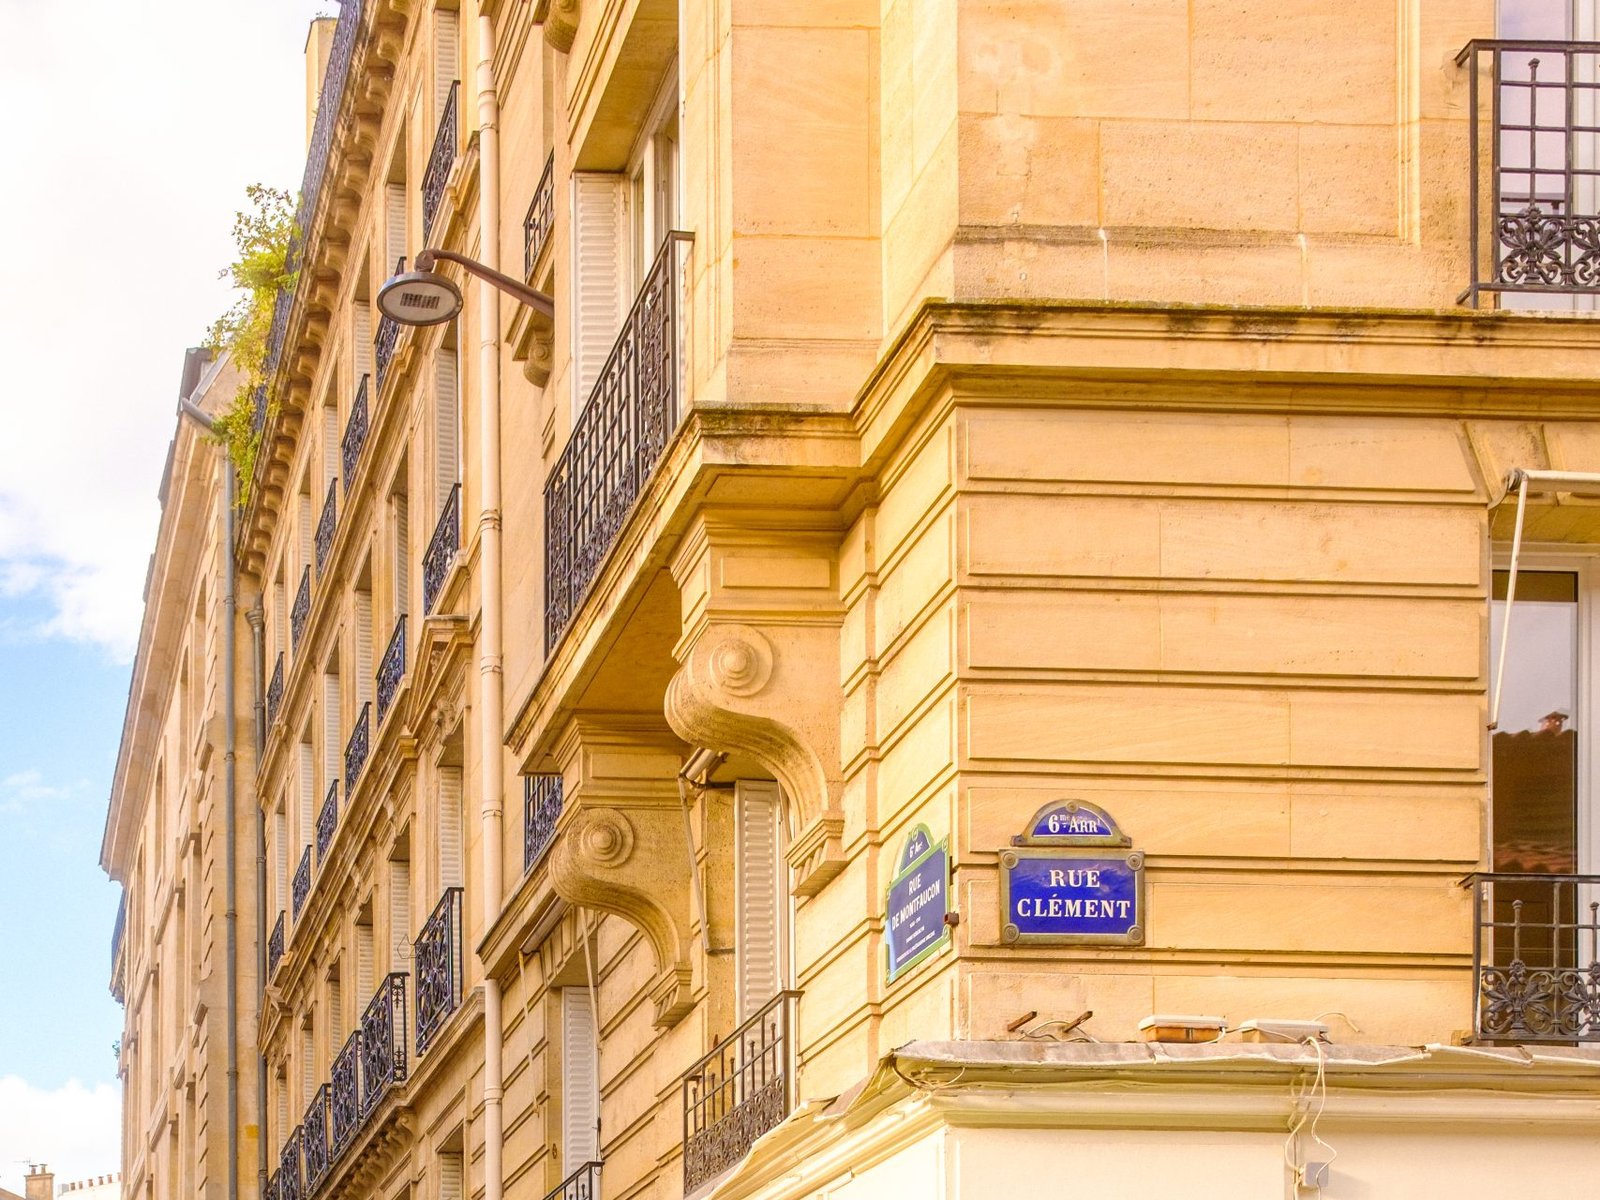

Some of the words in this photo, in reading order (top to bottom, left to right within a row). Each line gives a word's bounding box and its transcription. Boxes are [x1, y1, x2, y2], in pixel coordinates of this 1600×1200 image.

[908, 873, 922, 896] RUE
[1049, 869, 1100, 888] RUE
[891, 911, 900, 931] DE
[900, 879, 941, 924] MONTFAUCON
[1017, 893, 1131, 918] CLÉMENT
